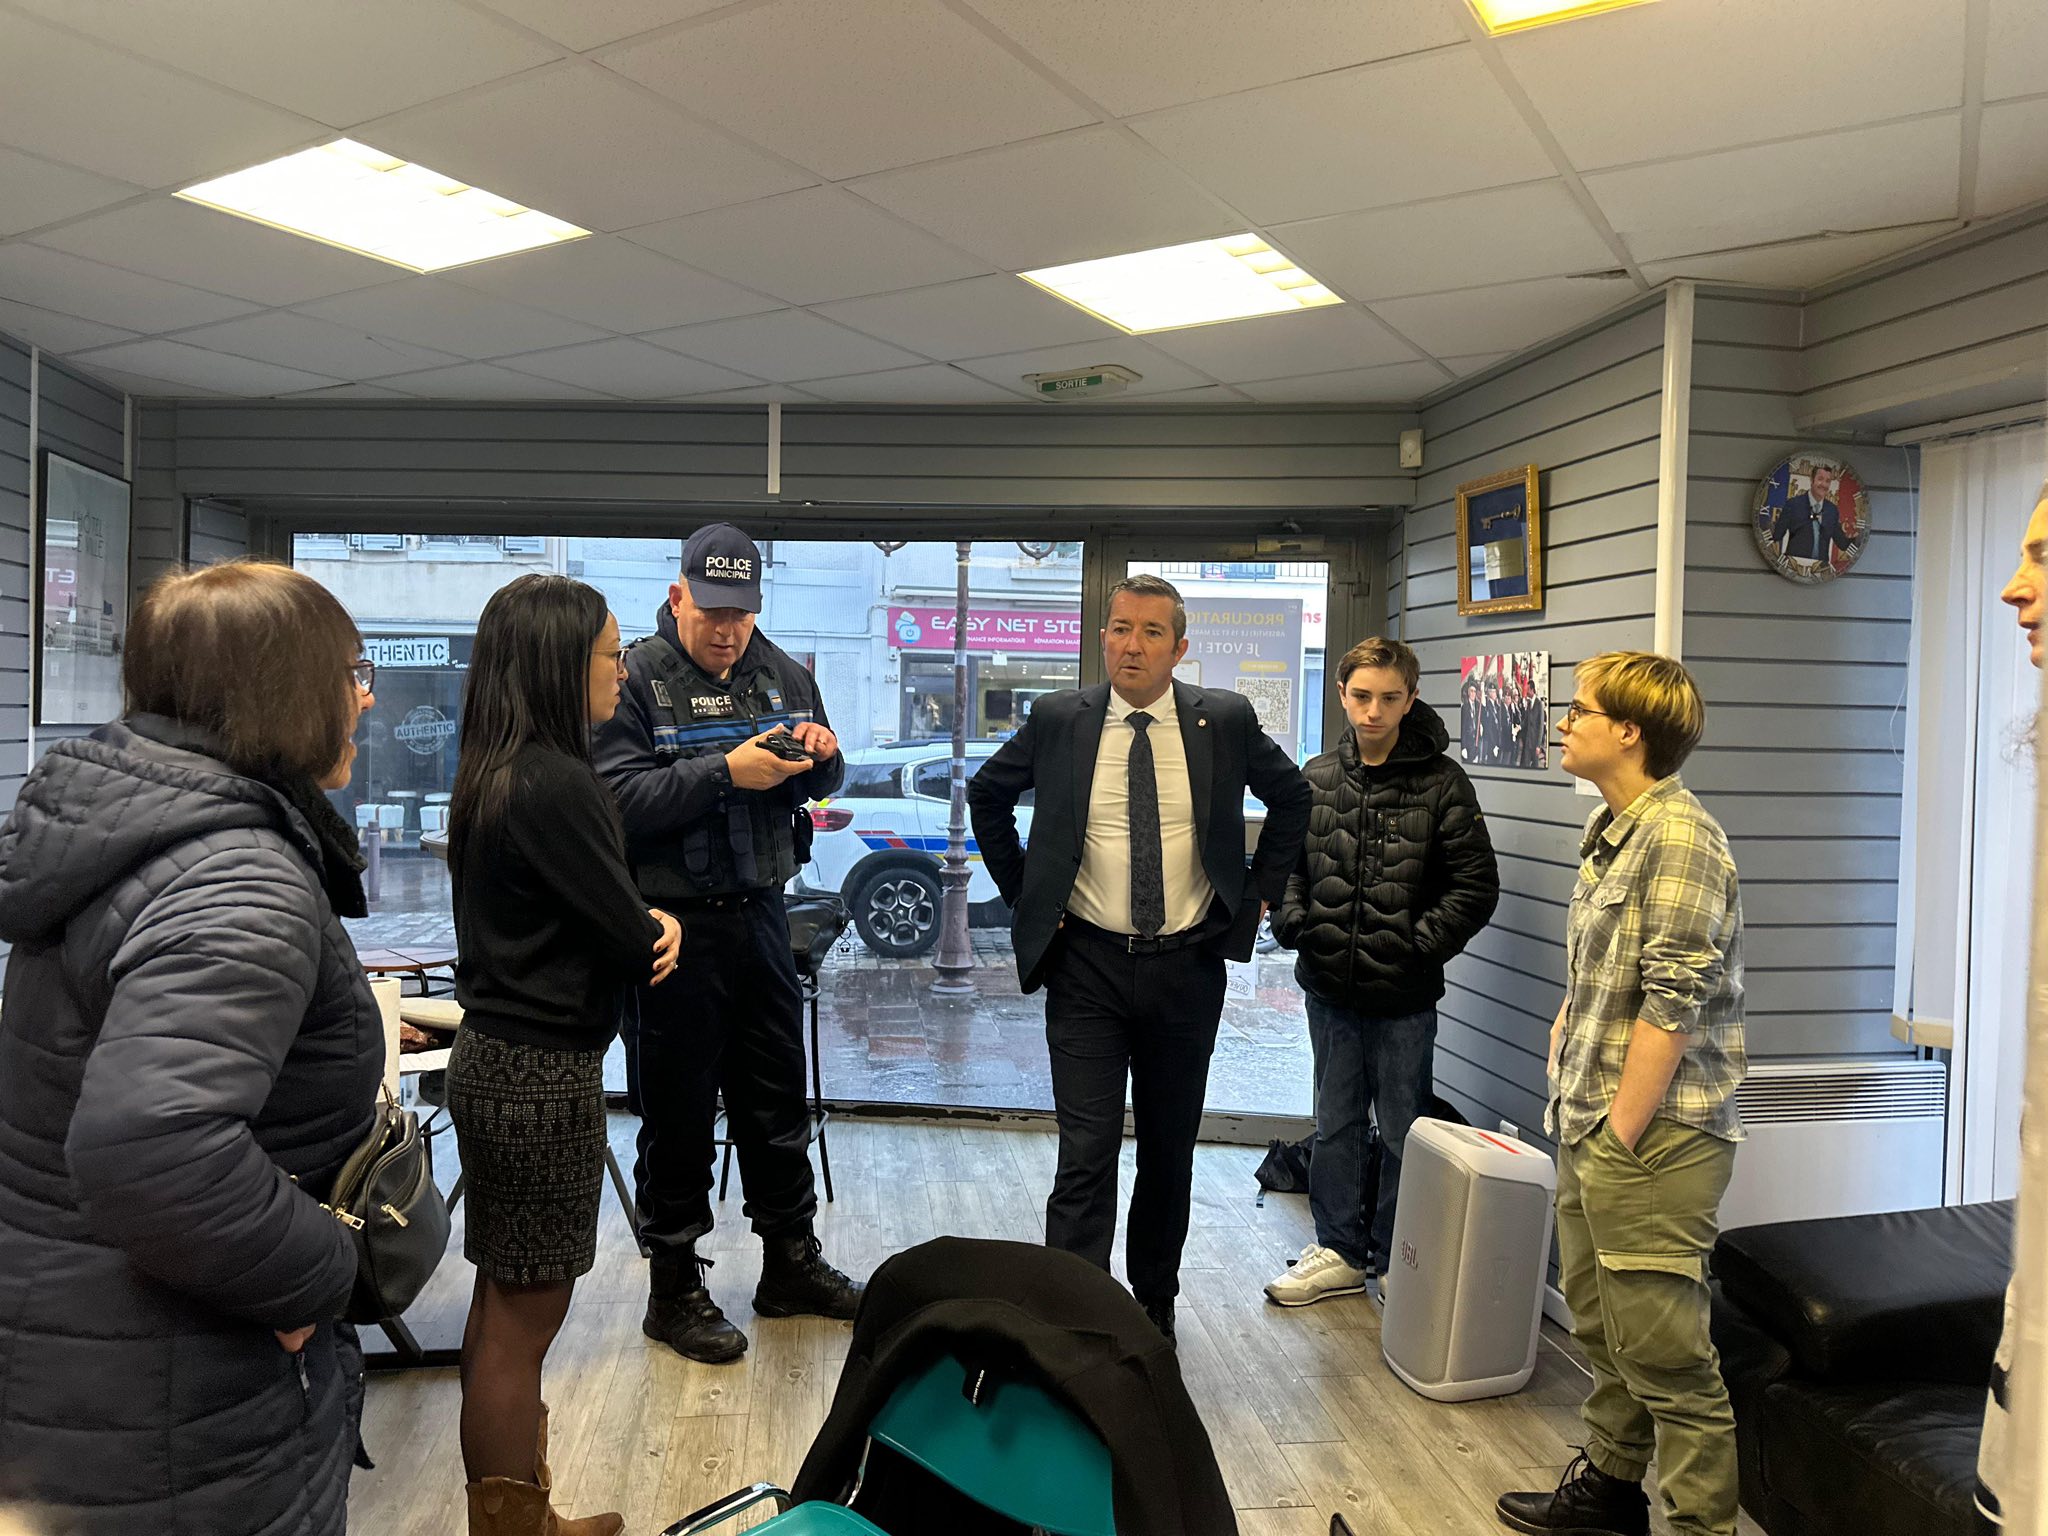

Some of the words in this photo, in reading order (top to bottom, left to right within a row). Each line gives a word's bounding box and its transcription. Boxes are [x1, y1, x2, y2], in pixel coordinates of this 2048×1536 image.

[1055, 378, 1088, 390] SORTIE
[705, 556, 752, 571] POLICE
[705, 569, 752, 580] MUNICIPALE
[1303, 612, 1322, 623] ns
[996, 618, 1038, 633] NET
[1044, 619, 1081, 634] STO
[368, 643, 445, 662] THENTIC
[690, 694, 732, 708] POLICE
[396, 722, 454, 738] AUTHENTIC
